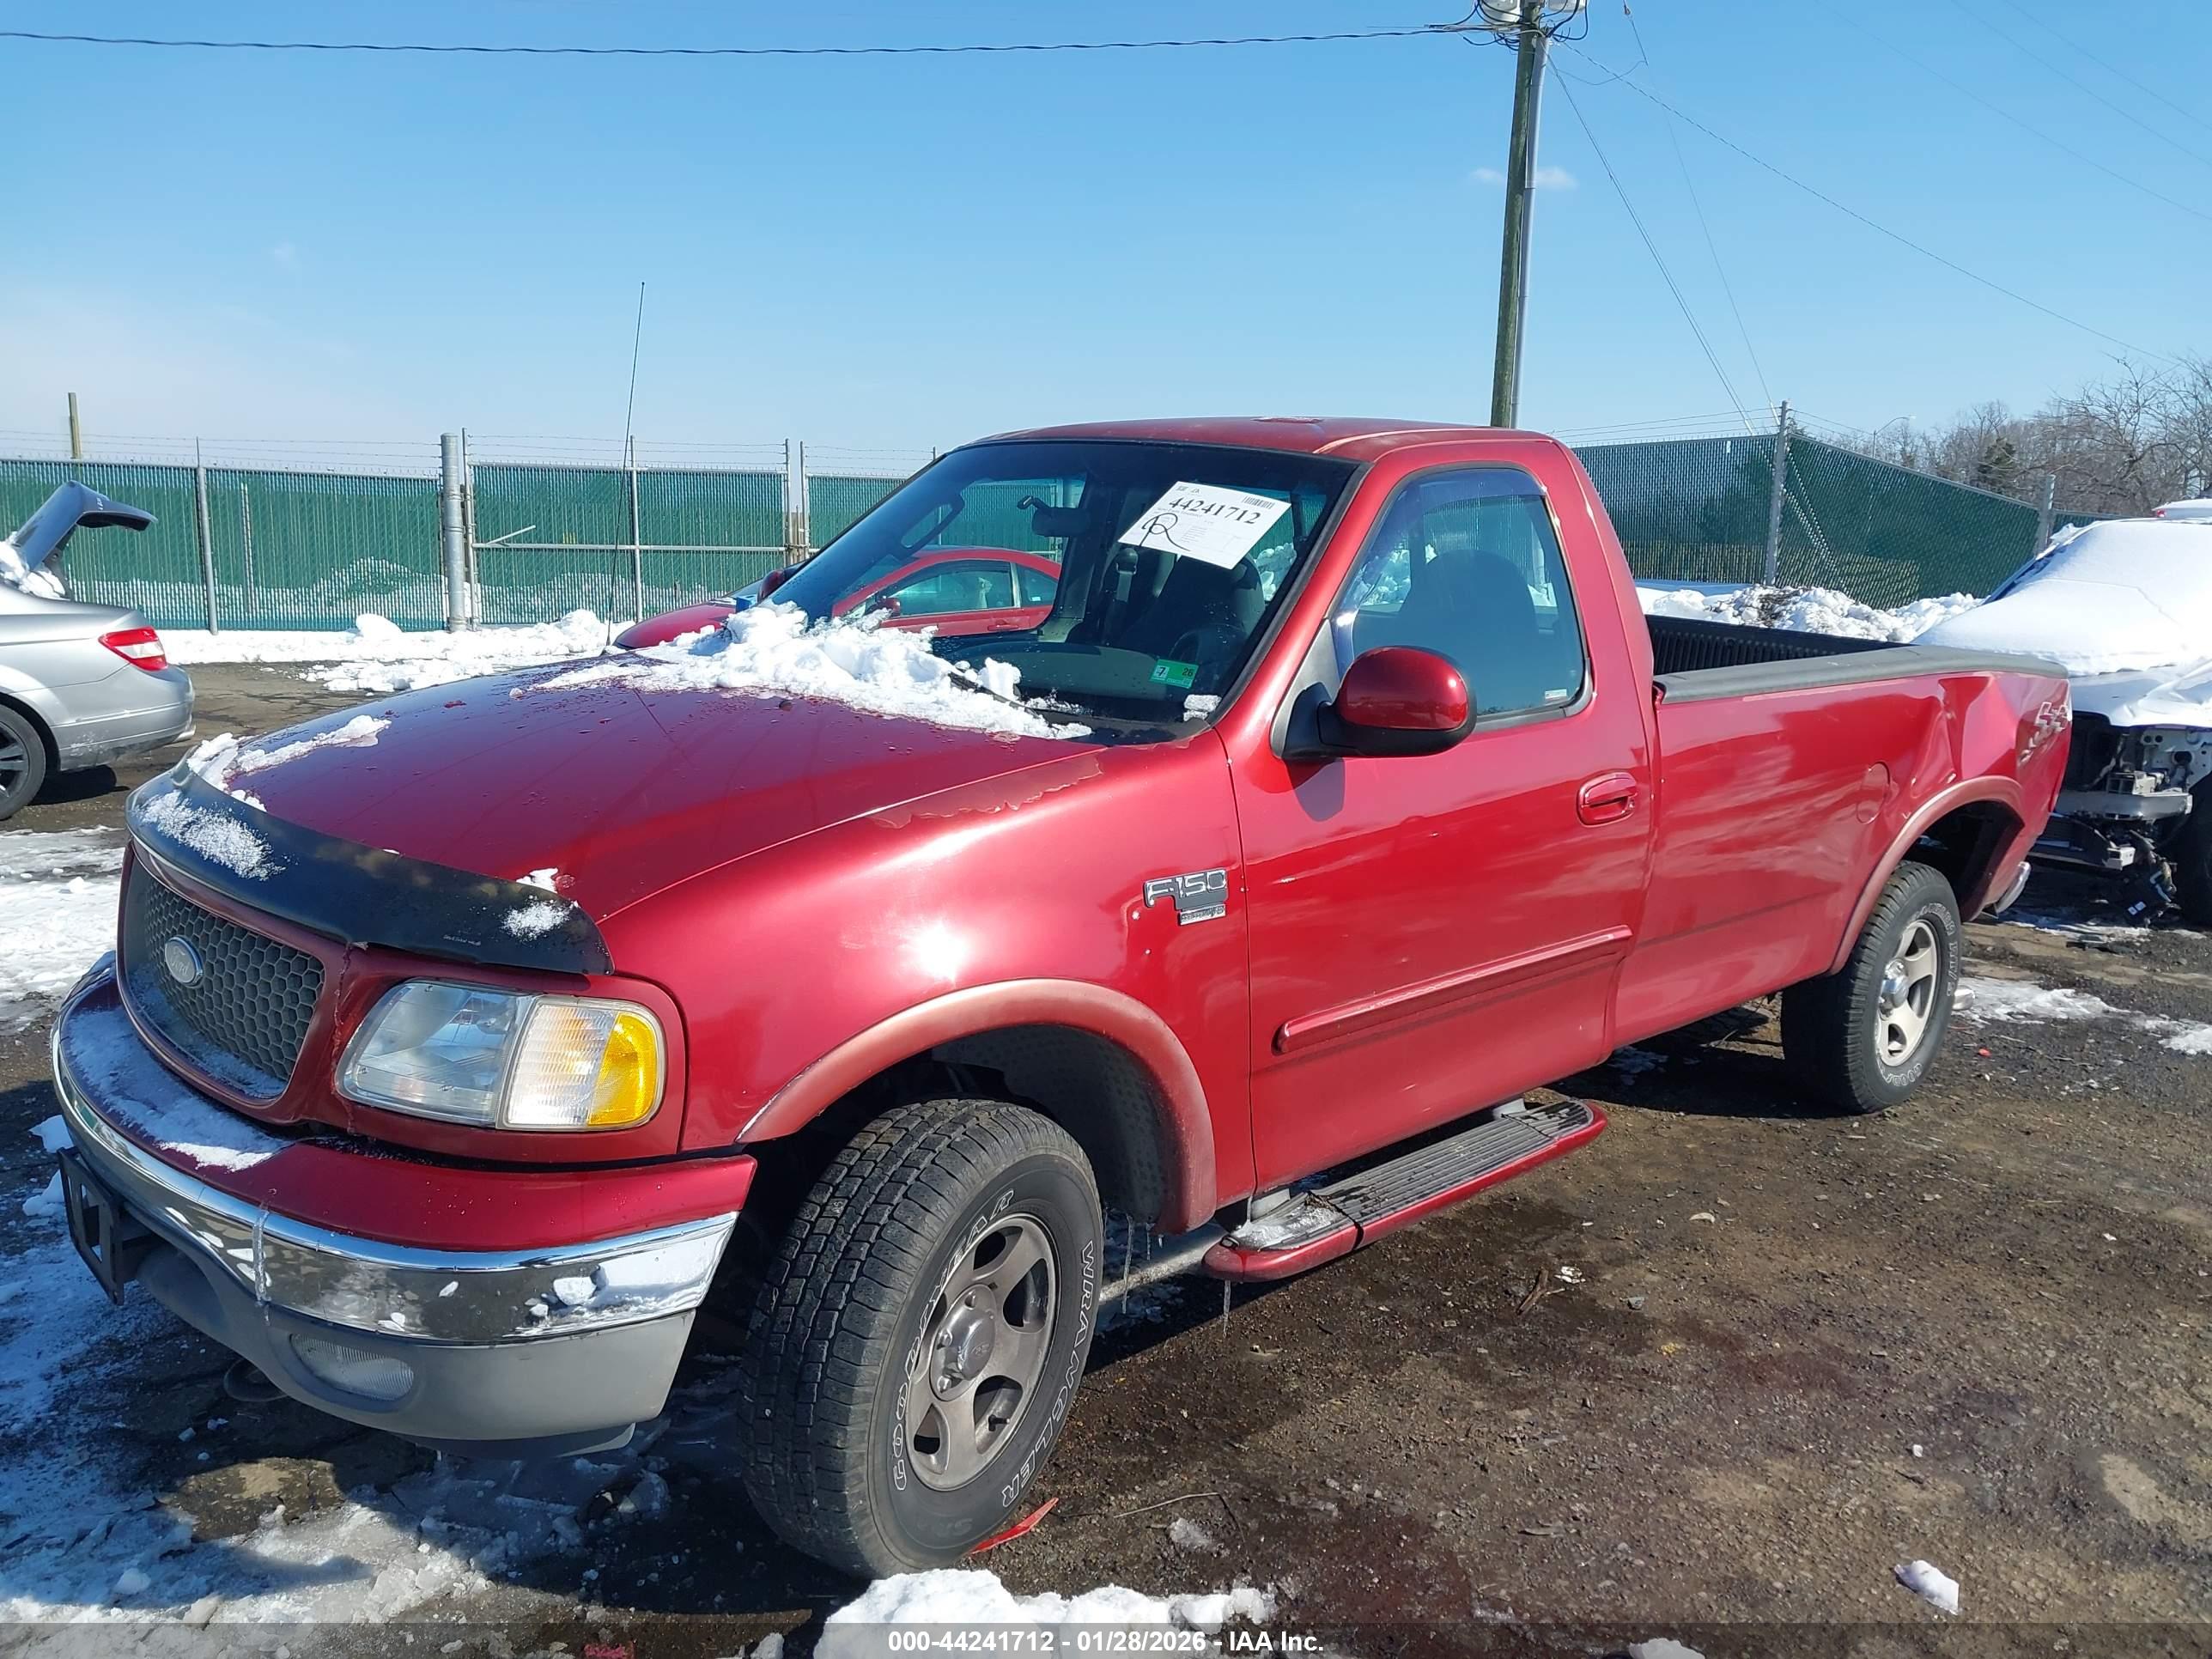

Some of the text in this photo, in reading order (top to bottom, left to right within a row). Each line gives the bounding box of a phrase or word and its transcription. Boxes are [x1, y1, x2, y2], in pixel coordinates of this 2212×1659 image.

[1169, 497, 1261, 525] 44241712
[1182, 667, 1194, 678] 26
[1002, 1239, 1094, 1508] WRANGLER
